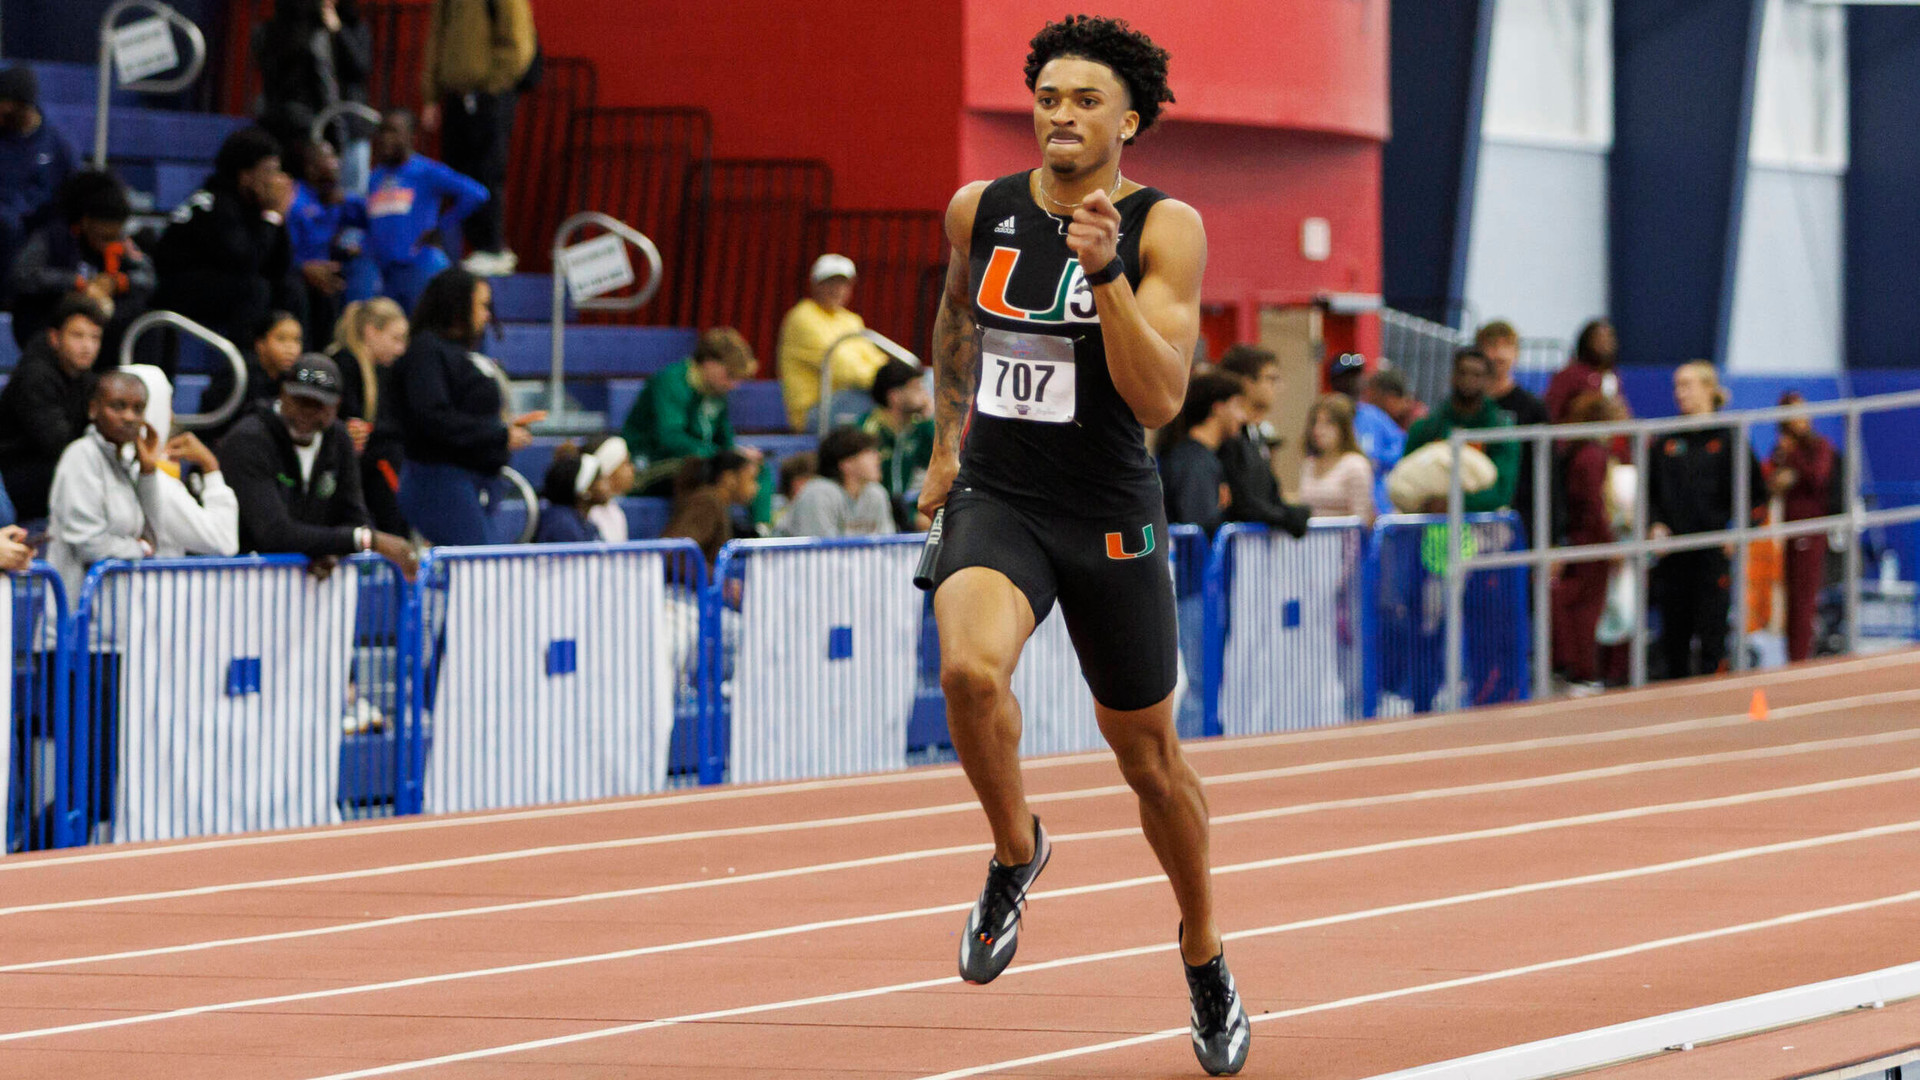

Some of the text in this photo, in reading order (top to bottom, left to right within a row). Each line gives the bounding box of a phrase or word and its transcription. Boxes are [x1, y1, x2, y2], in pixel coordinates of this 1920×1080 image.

[976, 245, 1080, 325] U
[995, 358, 1056, 403] 707
[1105, 523, 1156, 560] U
